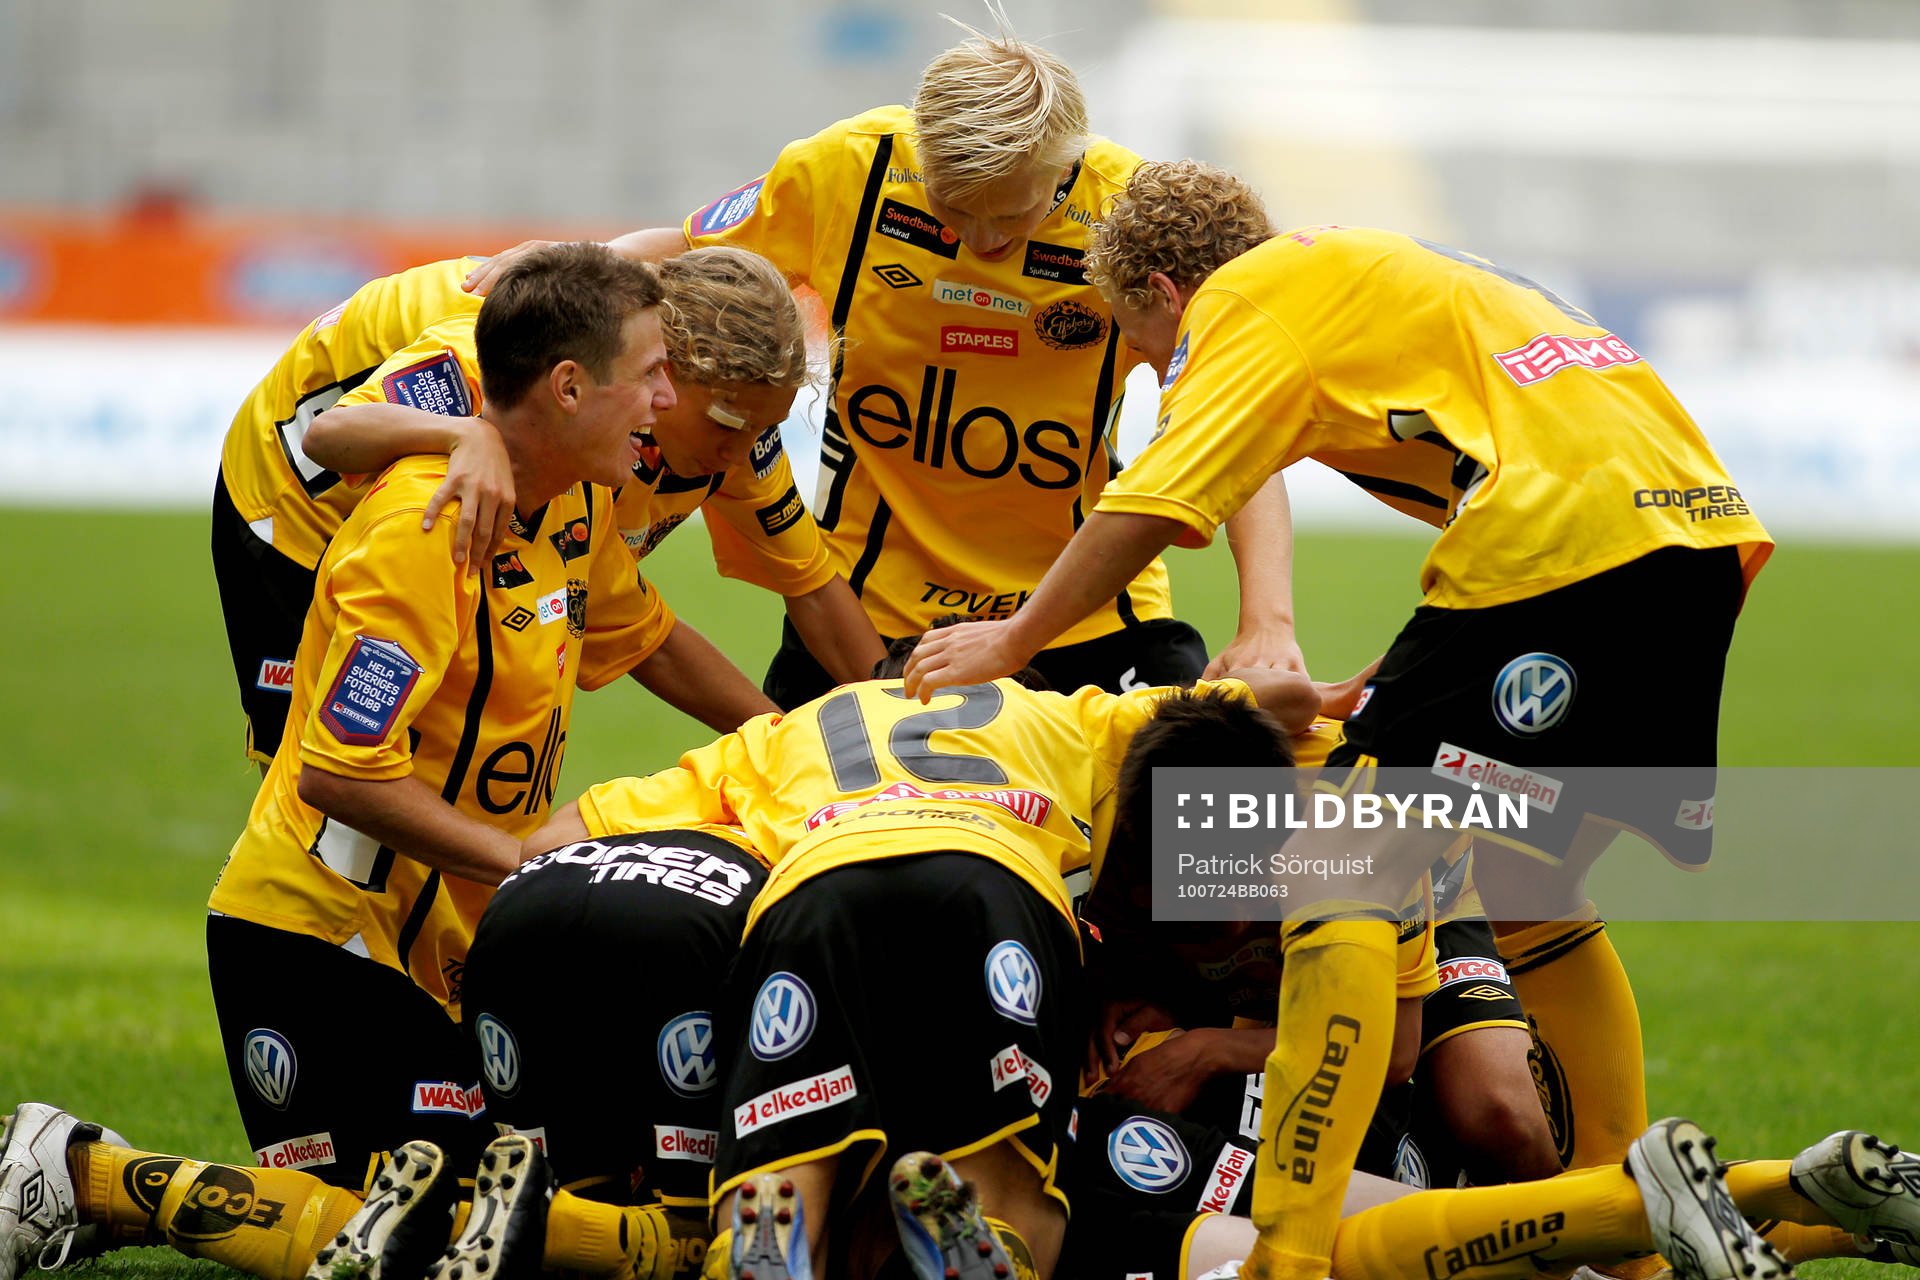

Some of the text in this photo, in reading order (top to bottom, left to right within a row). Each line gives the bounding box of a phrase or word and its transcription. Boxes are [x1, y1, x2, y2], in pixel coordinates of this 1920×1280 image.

[885, 207, 939, 237] Swedbank
[945, 332, 1014, 350] STAPLES
[437, 378, 454, 406] HELA
[847, 365, 1082, 490] ellos
[1633, 485, 1745, 509] COOPER
[1686, 503, 1750, 522] TIRES
[351, 665, 401, 696] SVERIGES
[367, 660, 395, 680] HELA
[344, 675, 396, 707] FOTBOLLS
[347, 690, 382, 713] KLUBB
[342, 707, 380, 730] STRYKTIPSET
[817, 679, 1009, 793] 12
[588, 861, 740, 907] TIRES
[760, 1074, 854, 1119] elkedjan
[1290, 1014, 1361, 1185] Camina
[273, 1138, 334, 1169] elkedjan
[1424, 1210, 1566, 1280] Camina
